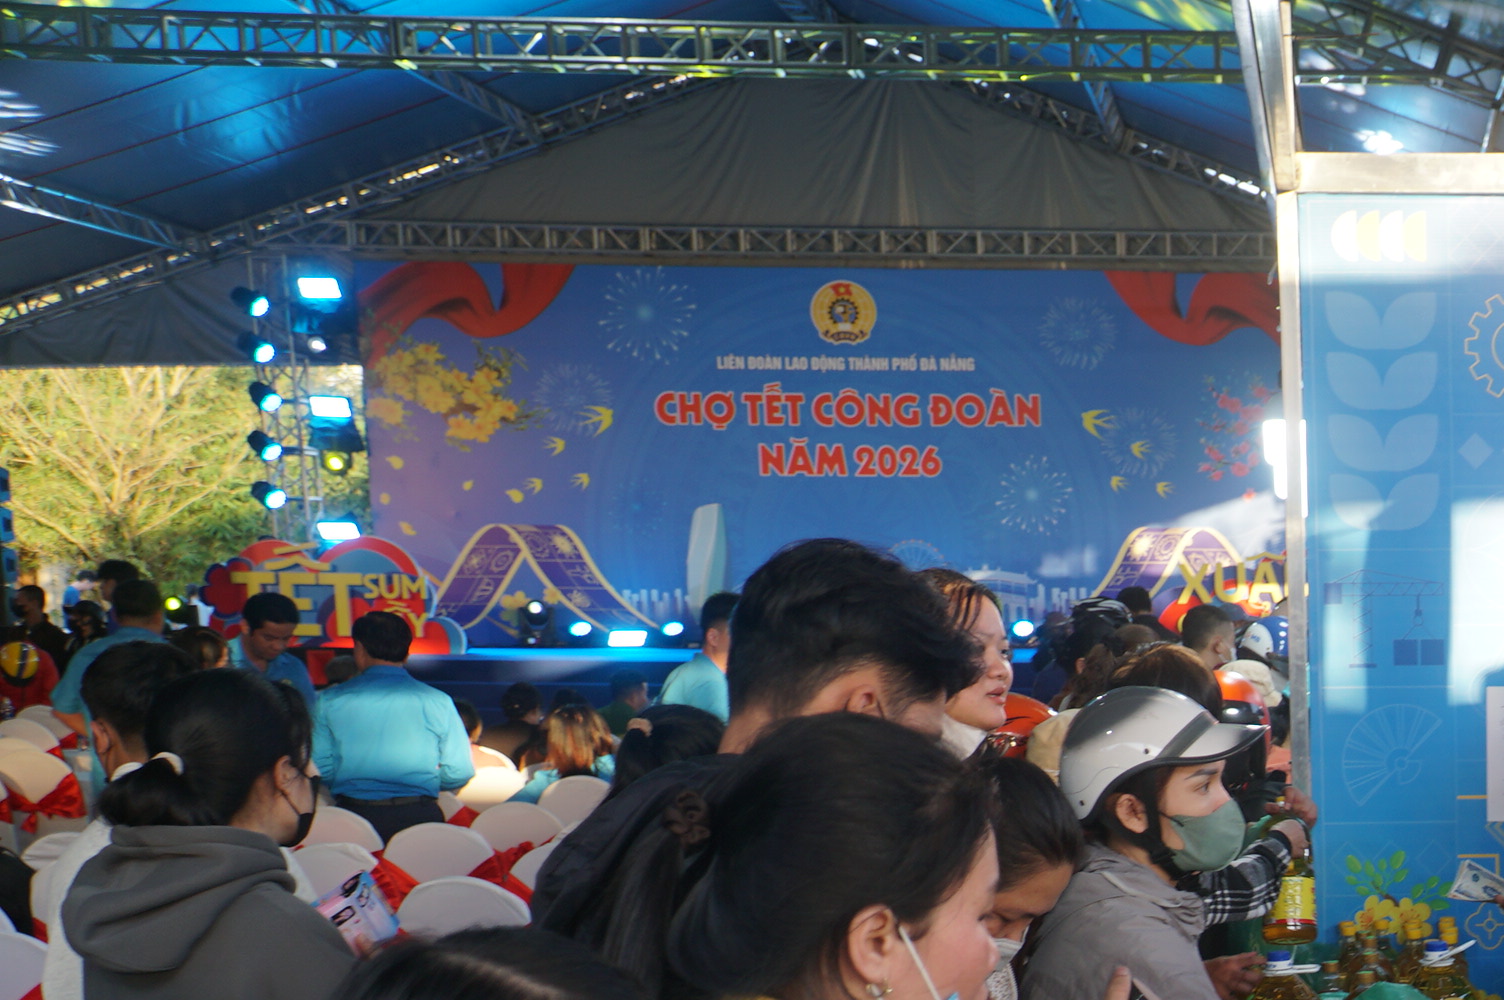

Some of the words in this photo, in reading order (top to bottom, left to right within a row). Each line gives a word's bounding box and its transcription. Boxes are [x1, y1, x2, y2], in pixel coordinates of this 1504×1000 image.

[717, 354, 745, 370] LIÊN
[747, 354, 782, 370] ĐOÀN
[785, 356, 808, 370] LAO
[810, 356, 845, 373] ĐỘNG
[849, 354, 889, 371] THÀNH
[892, 353, 917, 371] PHỐ
[920, 354, 937, 371] ĐÀ
[655, 391, 736, 430] CHỢ
[742, 382, 804, 426] TẾT
[811, 388, 922, 427] CÔNG
[928, 388, 1041, 427] ĐOÀN
[758, 437, 848, 477] NĂM
[854, 445, 942, 477] 2026
[230, 542, 363, 637] TẾT
[363, 573, 427, 599] SUM
[1177, 552, 1309, 604] XUÂ
